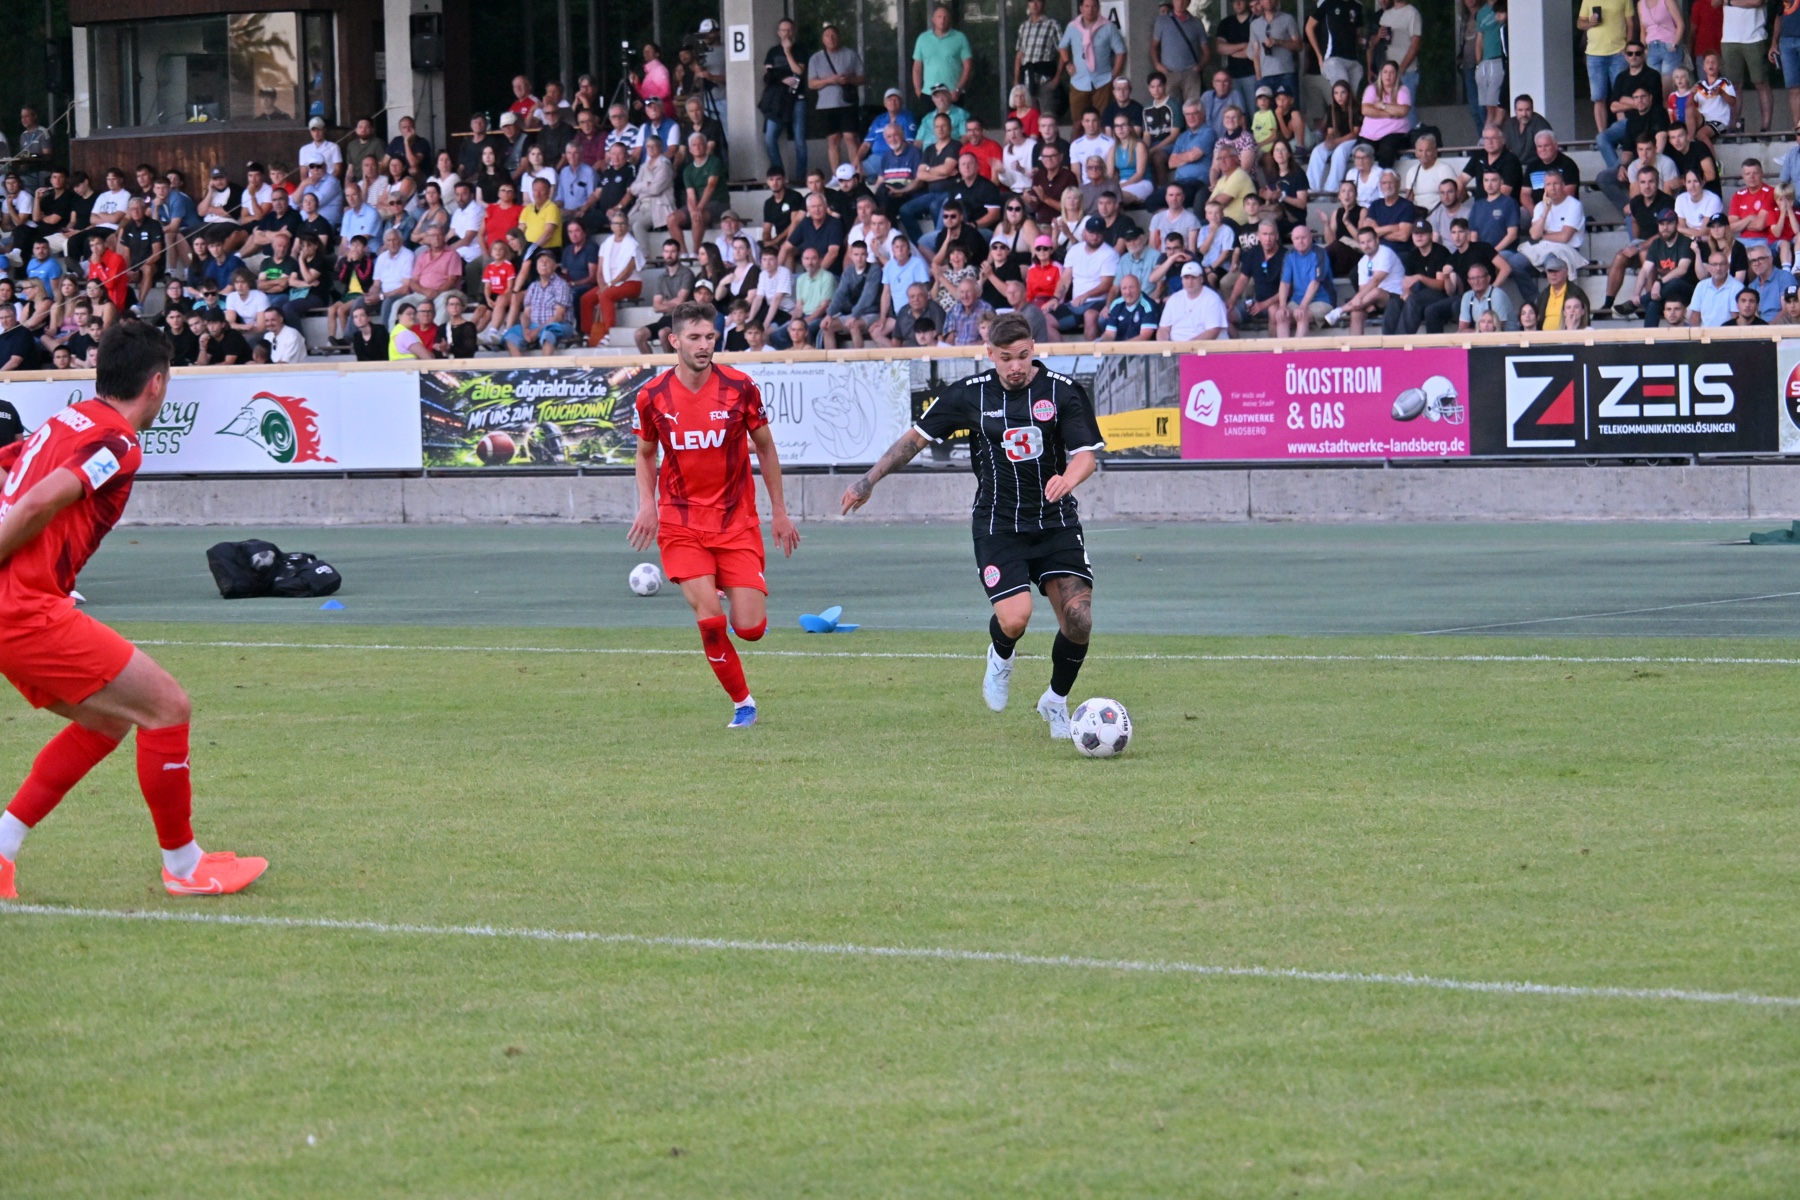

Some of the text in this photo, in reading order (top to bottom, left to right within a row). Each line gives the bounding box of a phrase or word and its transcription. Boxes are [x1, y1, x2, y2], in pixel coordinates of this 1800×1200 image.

[1108, 7, 1121, 30] A
[734, 31, 745, 53] B
[471, 379, 607, 402] aloe-digitaldruck.de
[1285, 363, 1382, 396] ÖKOSTROM
[1598, 363, 1735, 418] ZEIS
[756, 381, 803, 424] BAU
[467, 409, 491, 430] MIT
[490, 407, 511, 425] UNS
[512, 403, 534, 422] ZUM
[1224, 413, 1274, 423] STADTWERKE
[1286, 402, 1345, 430] & GAS
[670, 428, 727, 450] LEW
[1224, 426, 1266, 436] LANDSBERG
[1598, 421, 1736, 435] TELEKOMMUNIKATIONSLÖSUNGEN
[1287, 437, 1466, 456] www.stadtwerke-landsberg.de
